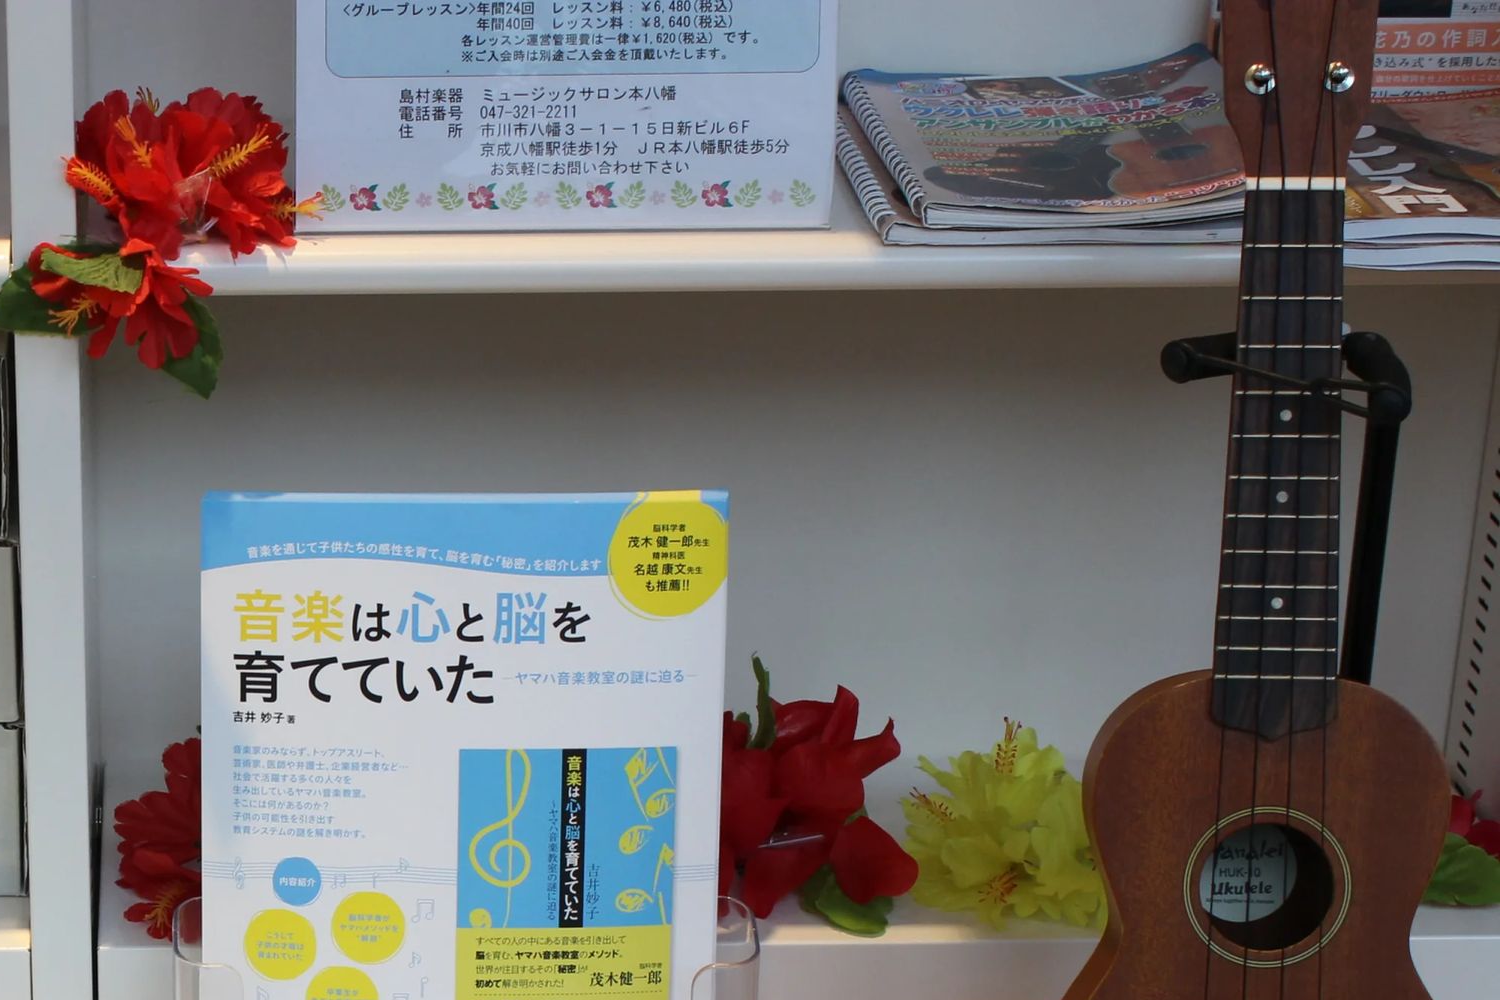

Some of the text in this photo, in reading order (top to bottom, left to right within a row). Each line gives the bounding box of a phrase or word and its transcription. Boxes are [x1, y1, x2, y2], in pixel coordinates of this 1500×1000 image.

[476, 17, 534, 31] 年間40回
[1375, 29, 1500, 49] 花乃の作詞
[399, 85, 677, 103] 島村楽器 ミュージックサロン本八幡
[399, 105, 577, 121] 電話番号 047-321-2211
[480, 140, 618, 157] 京成八幡駅徒歩1分
[490, 161, 690, 176] お気軽にお問い合わせ下さい
[652, 523, 687, 533] 脳科学者
[627, 536, 653, 549] 茂木
[652, 551, 685, 560] 精神科医
[634, 563, 659, 576] 名越
[233, 589, 592, 645] 音楽は心と脳を
[233, 650, 495, 704] 育てていた
[232, 711, 256, 723] 吉井
[260, 711, 285, 724] 妙子
[233, 772, 352, 785] 社会で活躍する多くの人々を
[232, 812, 334, 825] 子供の可能性を引き出す
[563, 755, 583, 921] 音楽は心と脳を育てていた
[279, 876, 317, 887] 内容紹介
[1211, 881, 1273, 896] Ukulele
[586, 864, 600, 920] 吉井妙子
[475, 935, 627, 946] すべての人の中にある音楽を引き出して
[475, 950, 623, 960] 脳を育む、ヤマハ音楽教室のメソッド。
[475, 964, 589, 975] 世界が注目するその「秘密」が
[589, 970, 662, 987] 茂木健一郎
